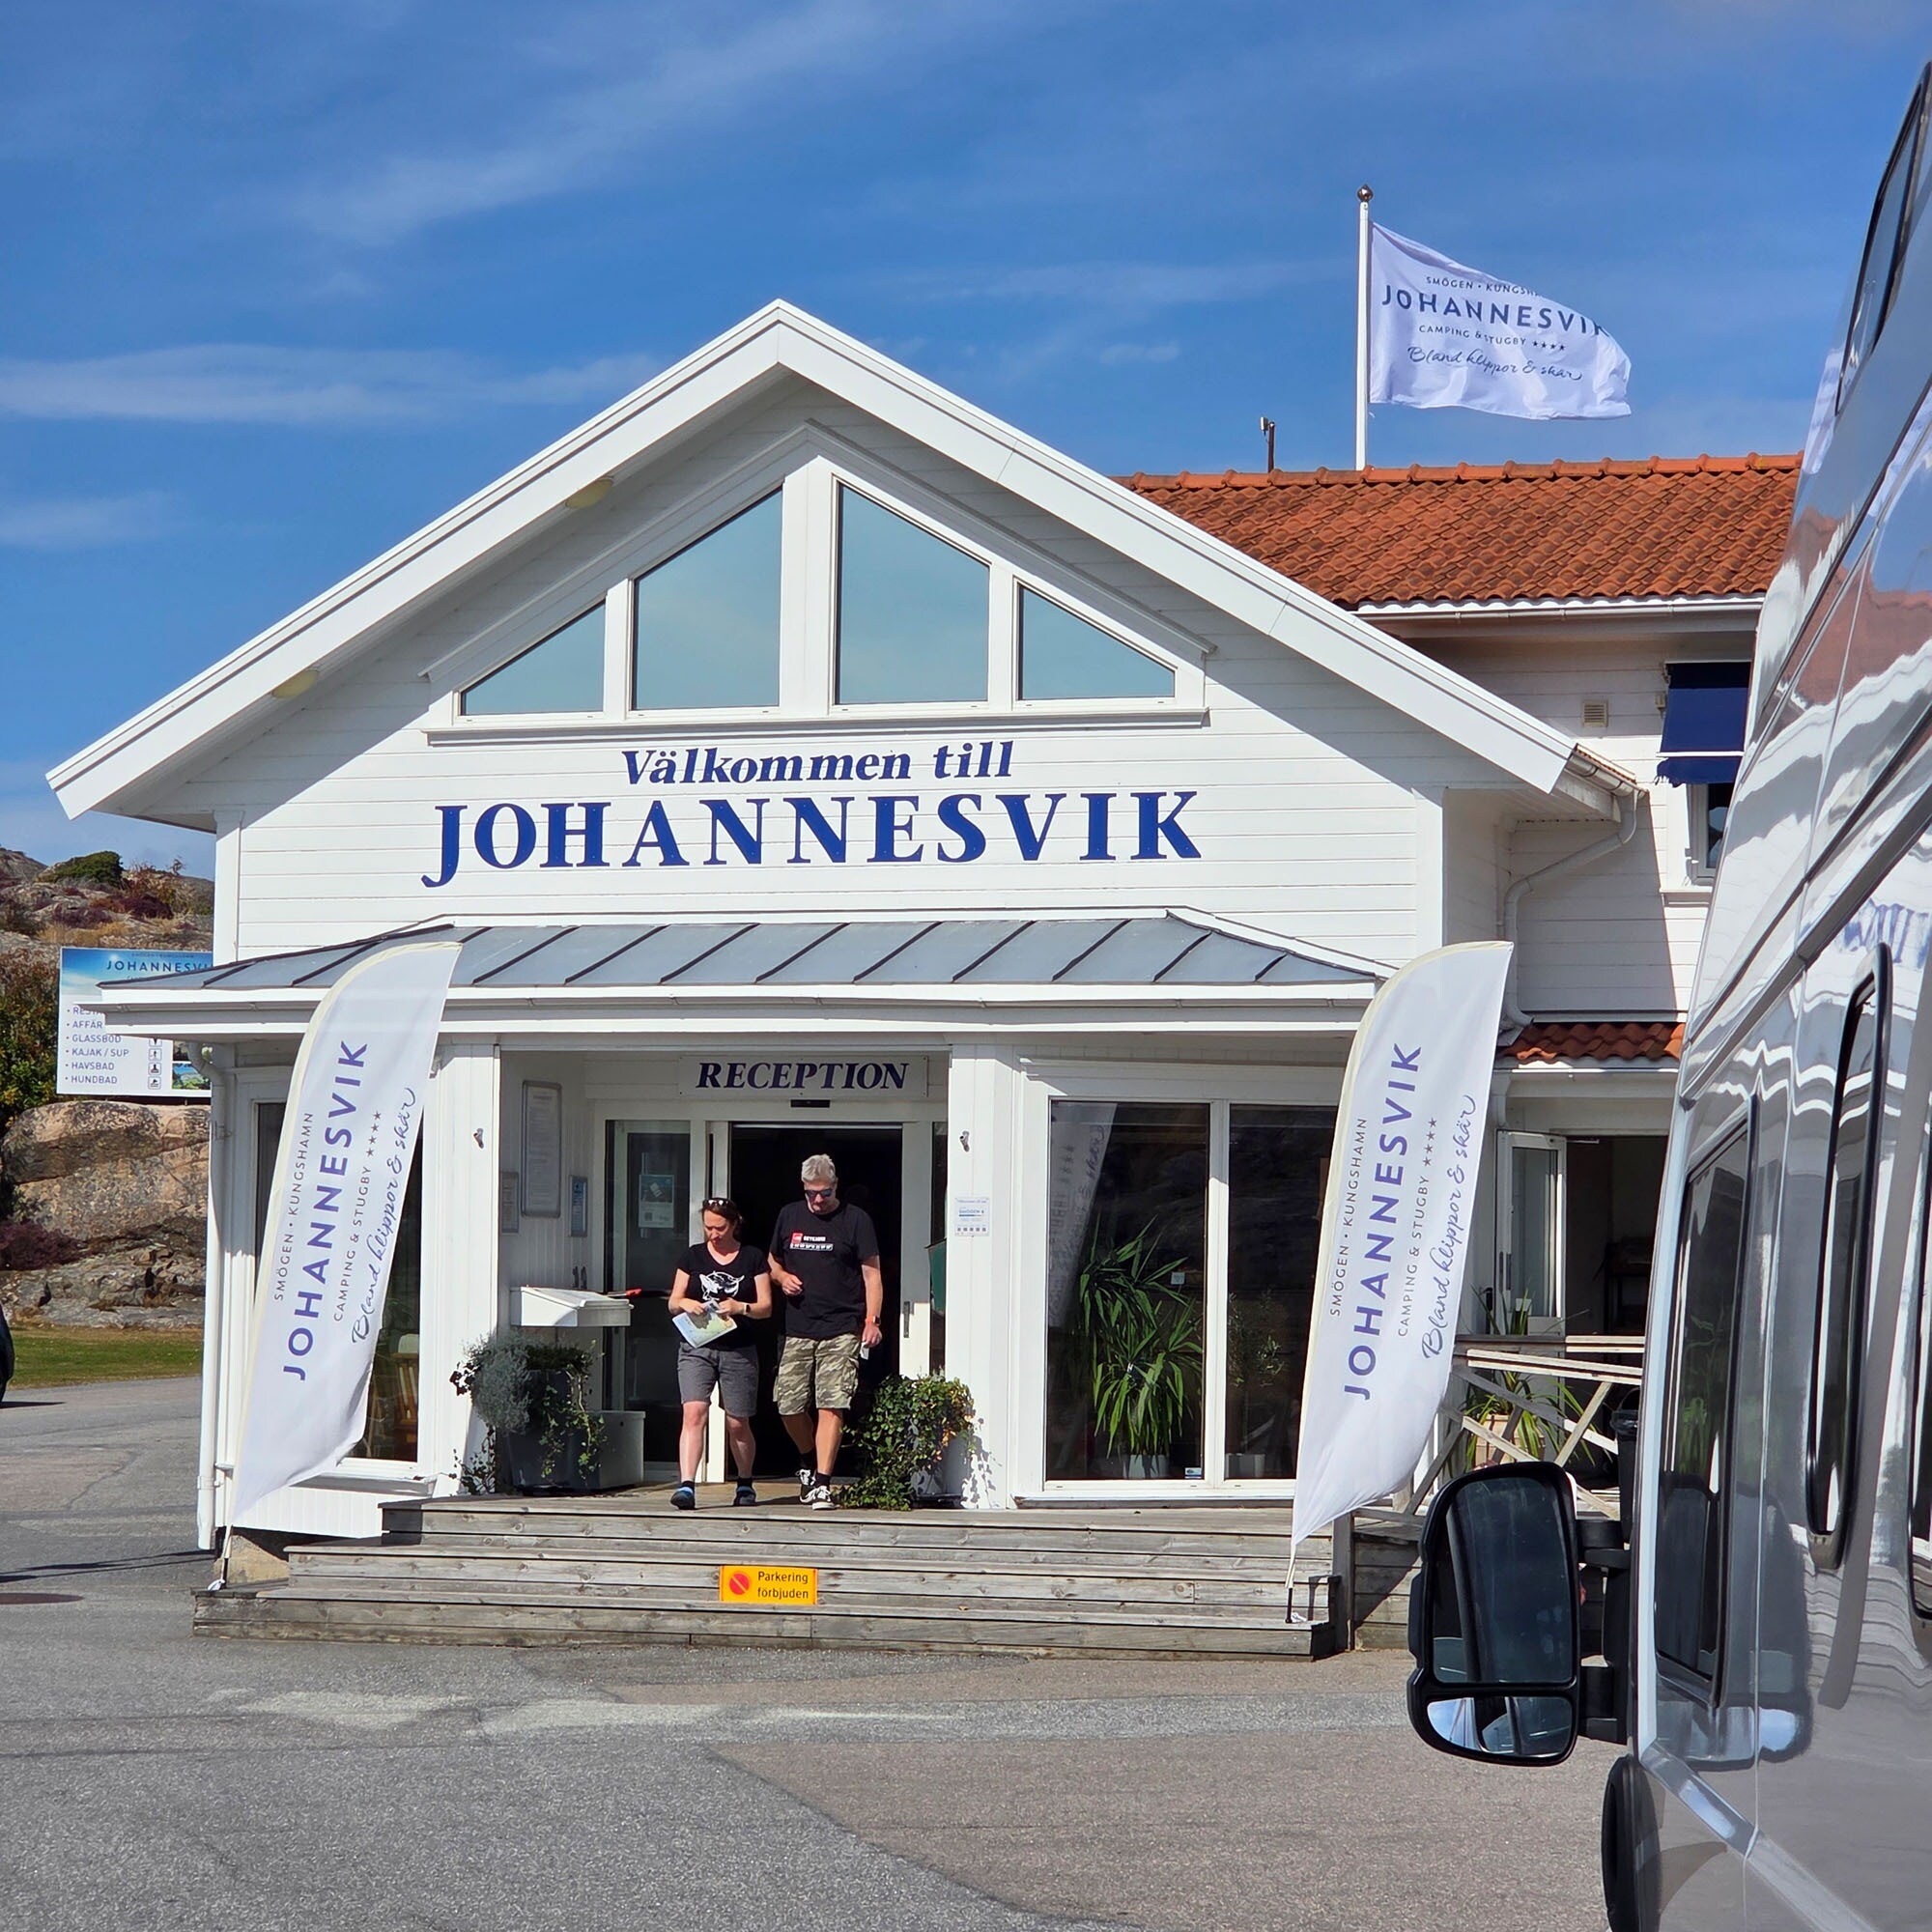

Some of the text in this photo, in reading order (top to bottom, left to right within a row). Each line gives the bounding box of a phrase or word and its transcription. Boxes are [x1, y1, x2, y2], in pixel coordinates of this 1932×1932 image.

[1426, 276, 1473, 290] SMÖGEN
[1407, 346, 1462, 363] Bland
[1419, 325, 1470, 338] CAMPING
[621, 740, 1014, 784] Välkommen till
[420, 790, 1202, 888] JOHANNESVIK
[71, 1048, 102, 1057] KAJAK
[110, 1049, 129, 1058] SUP
[71, 1062, 115, 1070] HAVSBAD
[71, 1075, 118, 1084] HUNDBAD
[696, 1063, 910, 1090] RECEPTION
[1453, 1094, 1476, 1158] skär
[274, 1113, 314, 1301] SMÖGEN KUNGSHAMN
[283, 1040, 368, 1381] JOHANNESVIK
[351, 1264, 381, 1343] Bland
[366, 1178, 398, 1262] klippor
[394, 1087, 416, 1150] skär
[1330, 1119, 1368, 1317] SMÖGEN KUNGSHAMN
[1344, 1043, 1421, 1401] JOHANNESVIK
[1430, 1188, 1464, 1272] klippor
[333, 1166, 371, 1321] CAMPING & STUGBY
[1398, 1176, 1430, 1337] CAMPING & STUGBY
[1421, 1276, 1450, 1359] Bland
[757, 1571, 809, 1584] Parkering
[757, 1587, 809, 1600] förbjuden
